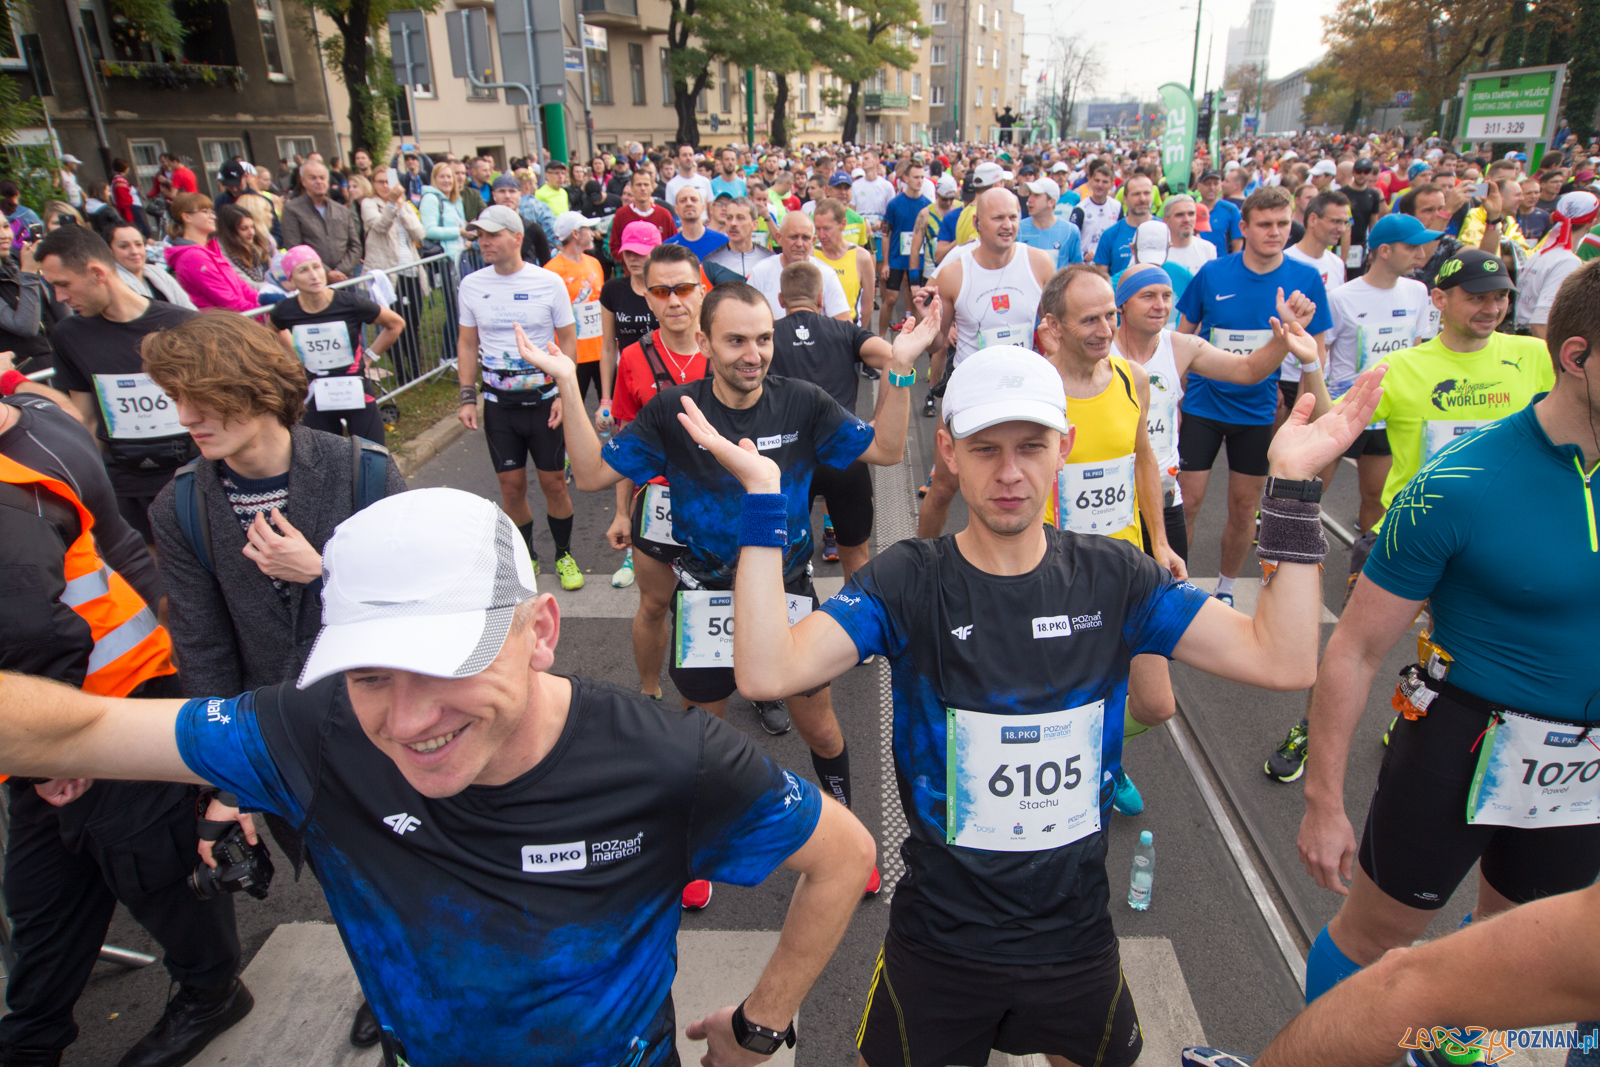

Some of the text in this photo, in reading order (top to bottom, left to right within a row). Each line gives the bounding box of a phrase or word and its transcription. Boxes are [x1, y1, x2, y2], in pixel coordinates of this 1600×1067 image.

[1473, 92, 1490, 100] STREFA
[1492, 90, 1520, 99] STARTOWA
[1524, 86, 1550, 98] WEJŚCIE
[1473, 102, 1496, 111] STARTING
[1497, 101, 1512, 110] ZONE
[1516, 99, 1545, 108] ENTRANCE
[1484, 122, 1500, 134] 3:11
[1506, 122, 1525, 134] 3:29
[616, 312, 650, 322] Nic mi
[306, 338, 340, 352] 3576
[1372, 339, 1408, 354] 4405
[116, 394, 168, 413] 3106
[1148, 419, 1164, 434] 44
[1076, 484, 1126, 510] 6386
[655, 506, 672, 520] 56
[708, 617, 734, 636] 50
[1037, 624, 1048, 632] 18.
[1050, 622, 1067, 631] PKO
[1074, 620, 1102, 630] maraton
[1018, 730, 1038, 738] PKO
[1044, 729, 1072, 738] maraton
[988, 754, 1082, 798] 6105
[1522, 758, 1600, 787] 1070
[825, 775, 848, 808] alenji
[1019, 798, 1058, 810] Stachu
[528, 854, 548, 864] 18.
[550, 850, 580, 863] PKO
[592, 845, 642, 862] maraton
